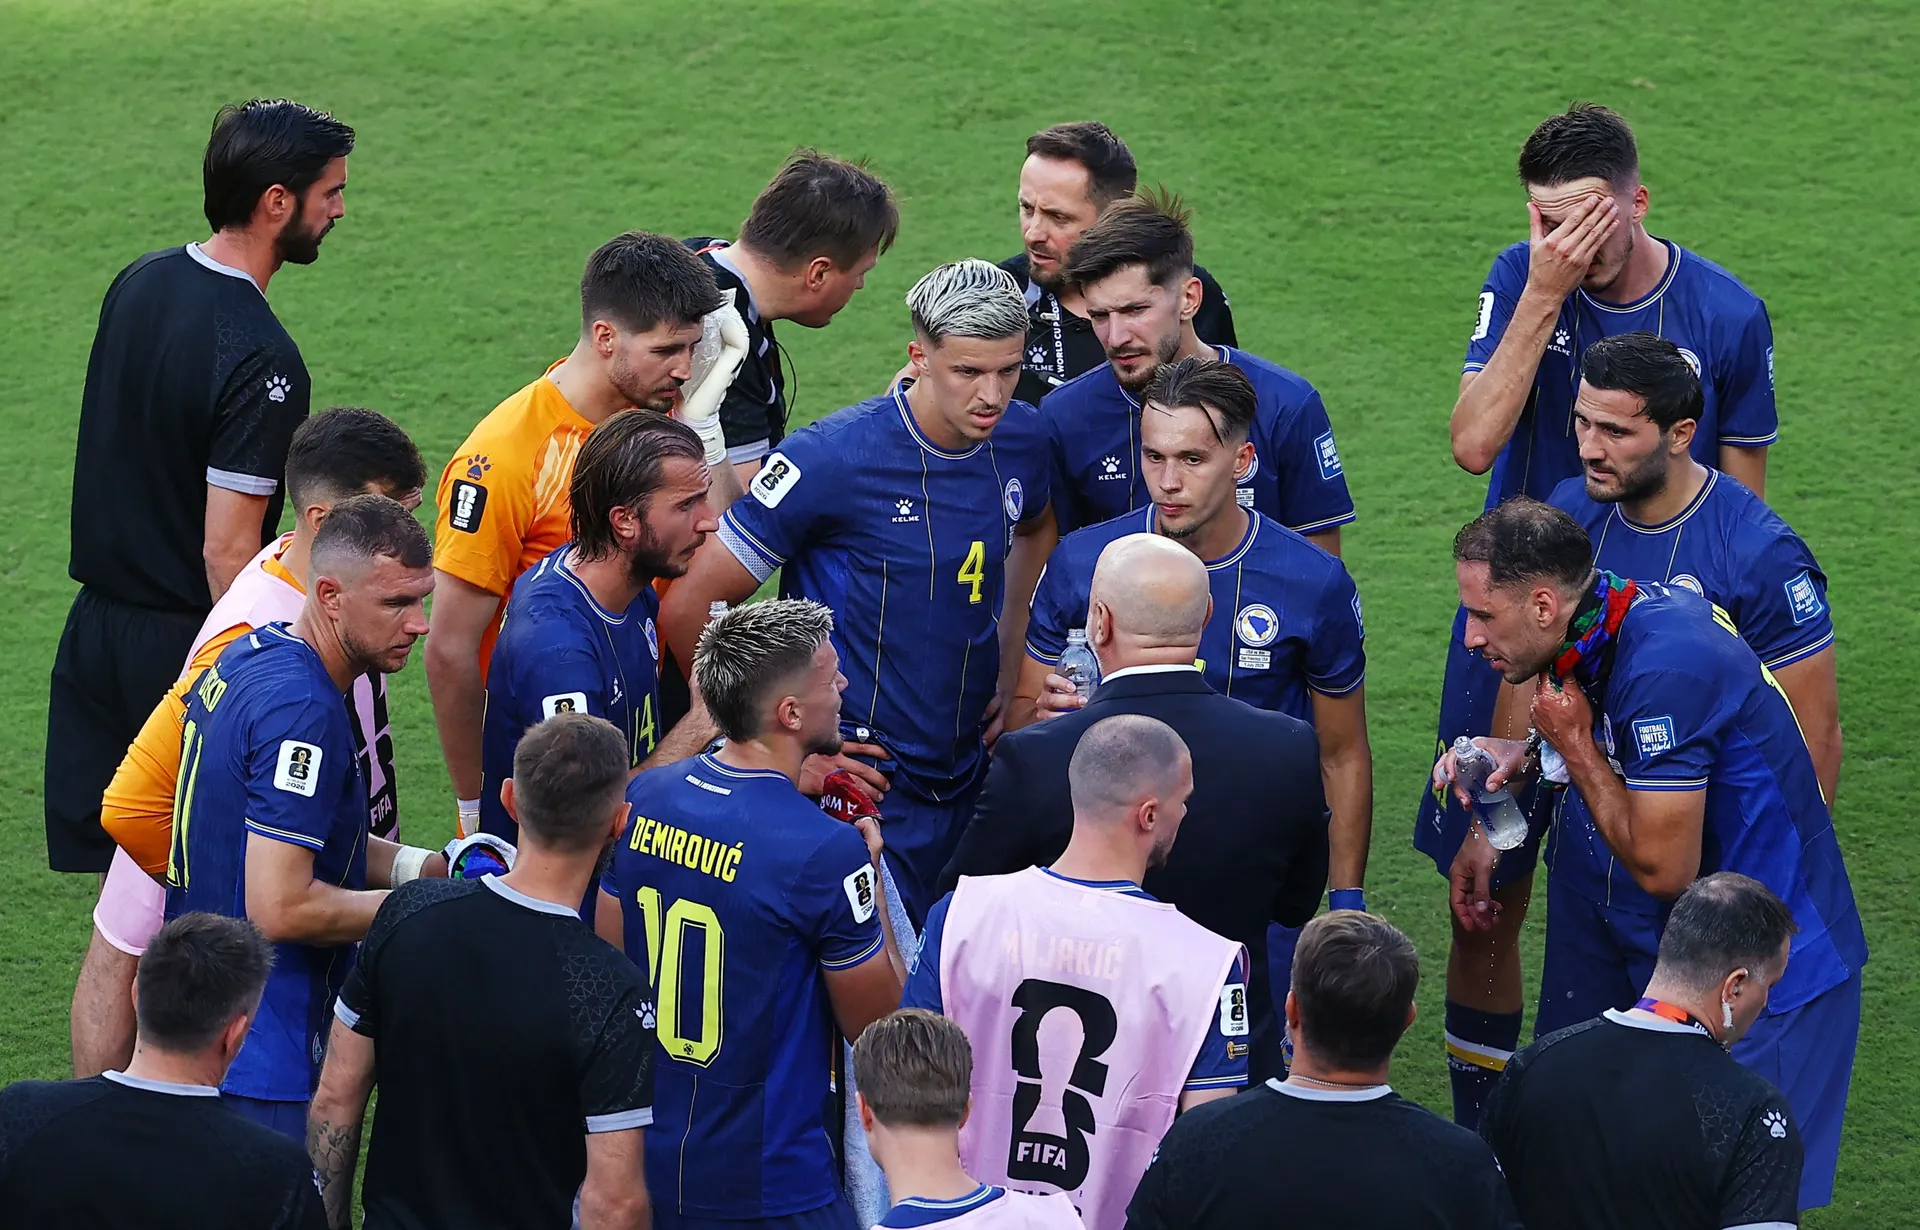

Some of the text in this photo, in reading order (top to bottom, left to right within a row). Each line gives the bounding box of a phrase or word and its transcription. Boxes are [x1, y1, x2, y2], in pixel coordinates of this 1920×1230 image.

[1053, 321, 1062, 340] CUP
[1055, 340, 1065, 373] WORLD
[1547, 344, 1571, 357] KELME
[1098, 473, 1127, 481] KELME
[892, 515, 920, 523] KELME
[957, 540, 986, 605] 4
[631, 692, 656, 768] 14
[1638, 723, 1667, 734] FOOTBALL
[1640, 731, 1669, 744] UNITES
[1641, 740, 1671, 753] the World
[286, 782, 305, 790] 2026
[165, 718, 203, 894] 11
[369, 793, 393, 828] FIFA
[819, 794, 842, 812] WOR
[629, 815, 744, 884] DEMIROVIĆ
[636, 885, 725, 1068] 10
[1016, 1141, 1067, 1171] FIFA
